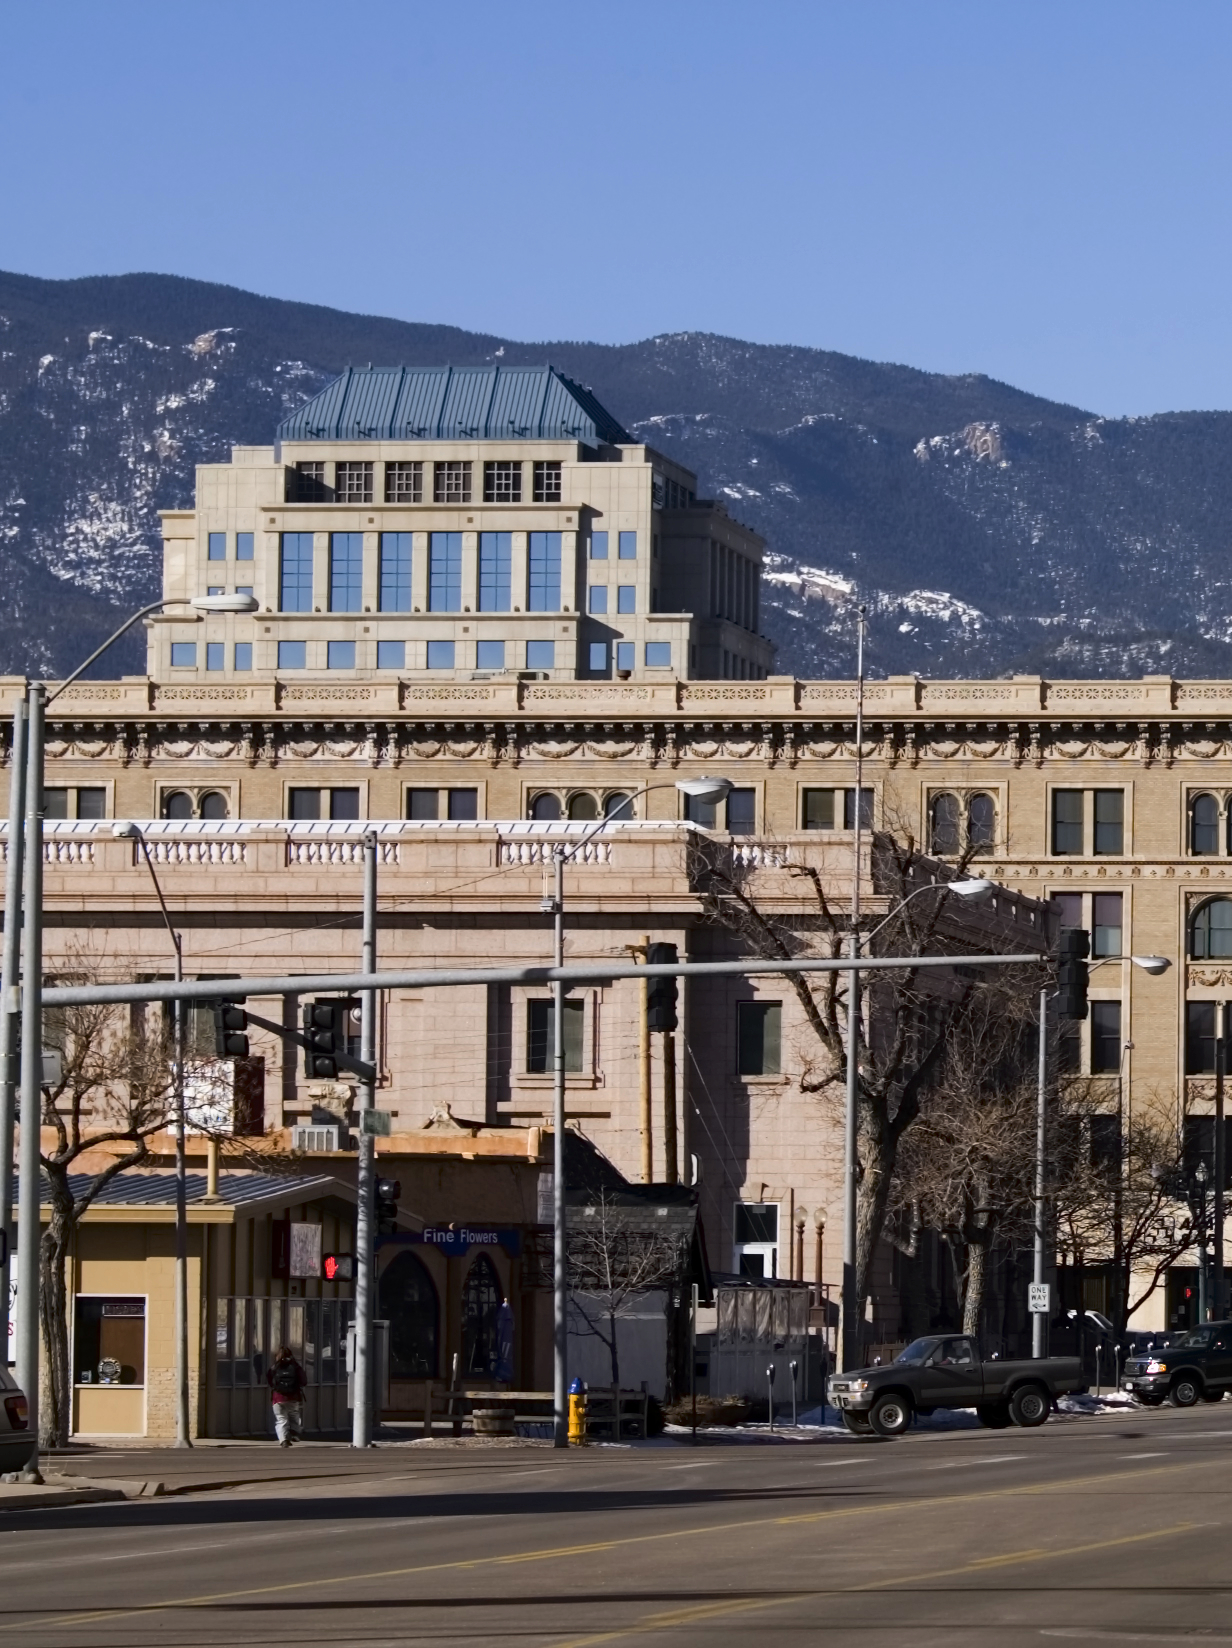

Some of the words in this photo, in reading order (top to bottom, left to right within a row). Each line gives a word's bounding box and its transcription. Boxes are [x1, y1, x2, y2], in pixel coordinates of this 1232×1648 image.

[423, 1228, 455, 1243] Fine
[460, 1229, 498, 1243] Flowers
[1031, 1286, 1047, 1294] ONE
